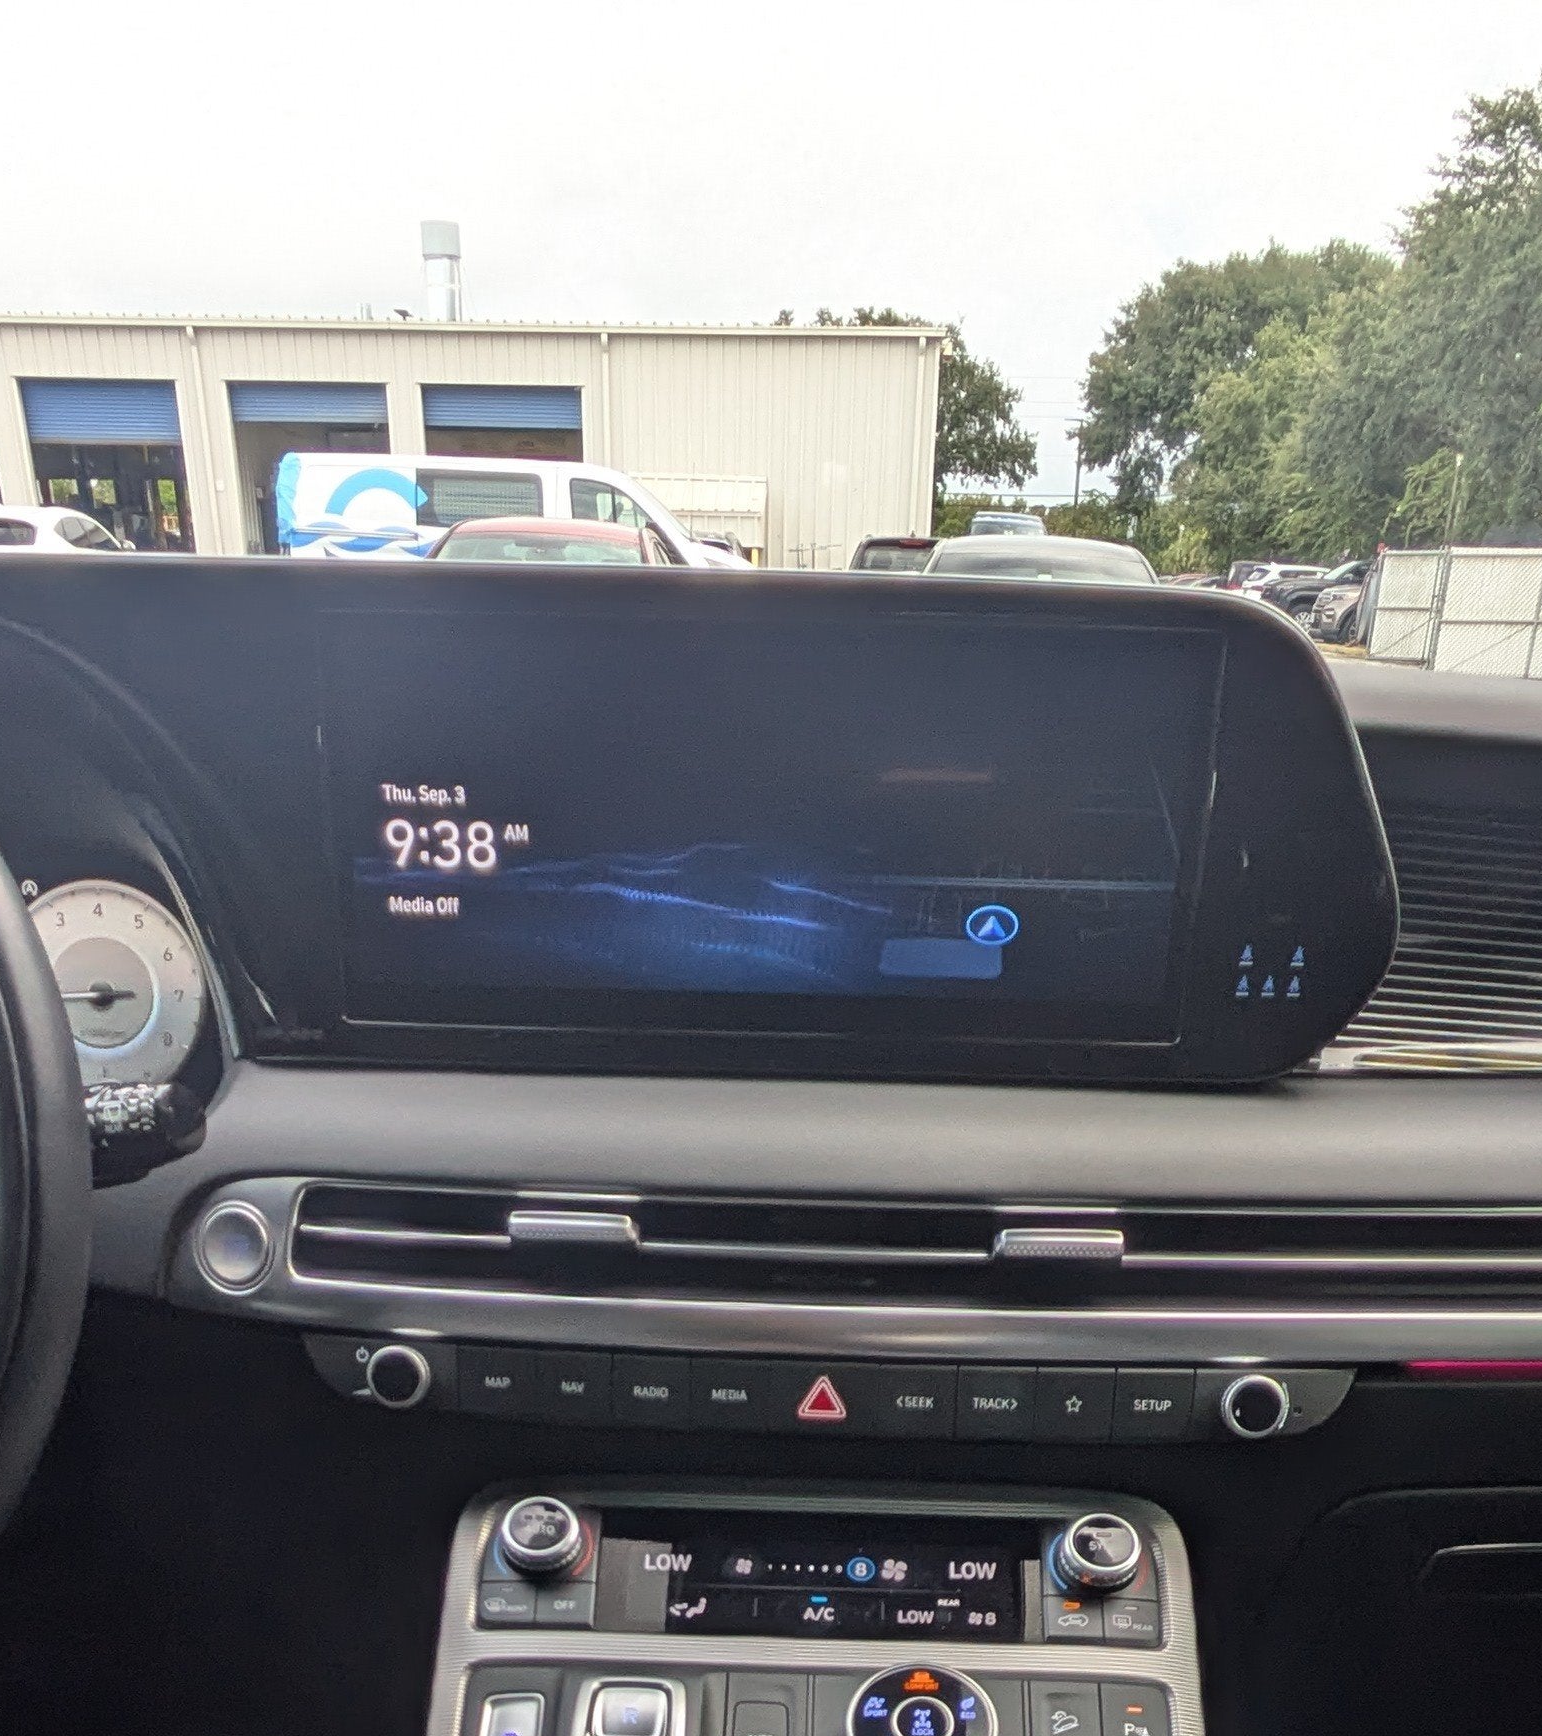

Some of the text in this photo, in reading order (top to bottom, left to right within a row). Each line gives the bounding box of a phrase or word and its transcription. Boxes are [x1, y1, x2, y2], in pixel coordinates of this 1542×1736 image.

[385, 818, 530, 870] 9:38 AM
[93, 903, 103, 917] 4
[389, 896, 459, 914] Media Off
[56, 912, 65, 927] 3
[134, 914, 144, 929] 5
[163, 947, 173, 961] 6
[485, 1376, 511, 1388] MAP
[561, 1380, 585, 1393] NAV
[633, 1385, 669, 1399] RADIO
[711, 1388, 748, 1401] MEDIA
[1133, 1398, 1172, 1411] SETUP
[643, 1553, 693, 1572] LOW
[948, 1560, 996, 1581] LOW
[554, 1600, 576, 1610] OFF
[937, 1598, 960, 1607] REAR
[803, 1606, 835, 1622] A/C
[896, 1609, 935, 1625] LOW
[984, 1611, 997, 1626] 8
[622, 1707, 640, 1724] R
[863, 1709, 888, 1718] SPORT
[960, 1711, 976, 1720] ECO
[912, 1728, 935, 1736] LOCK
